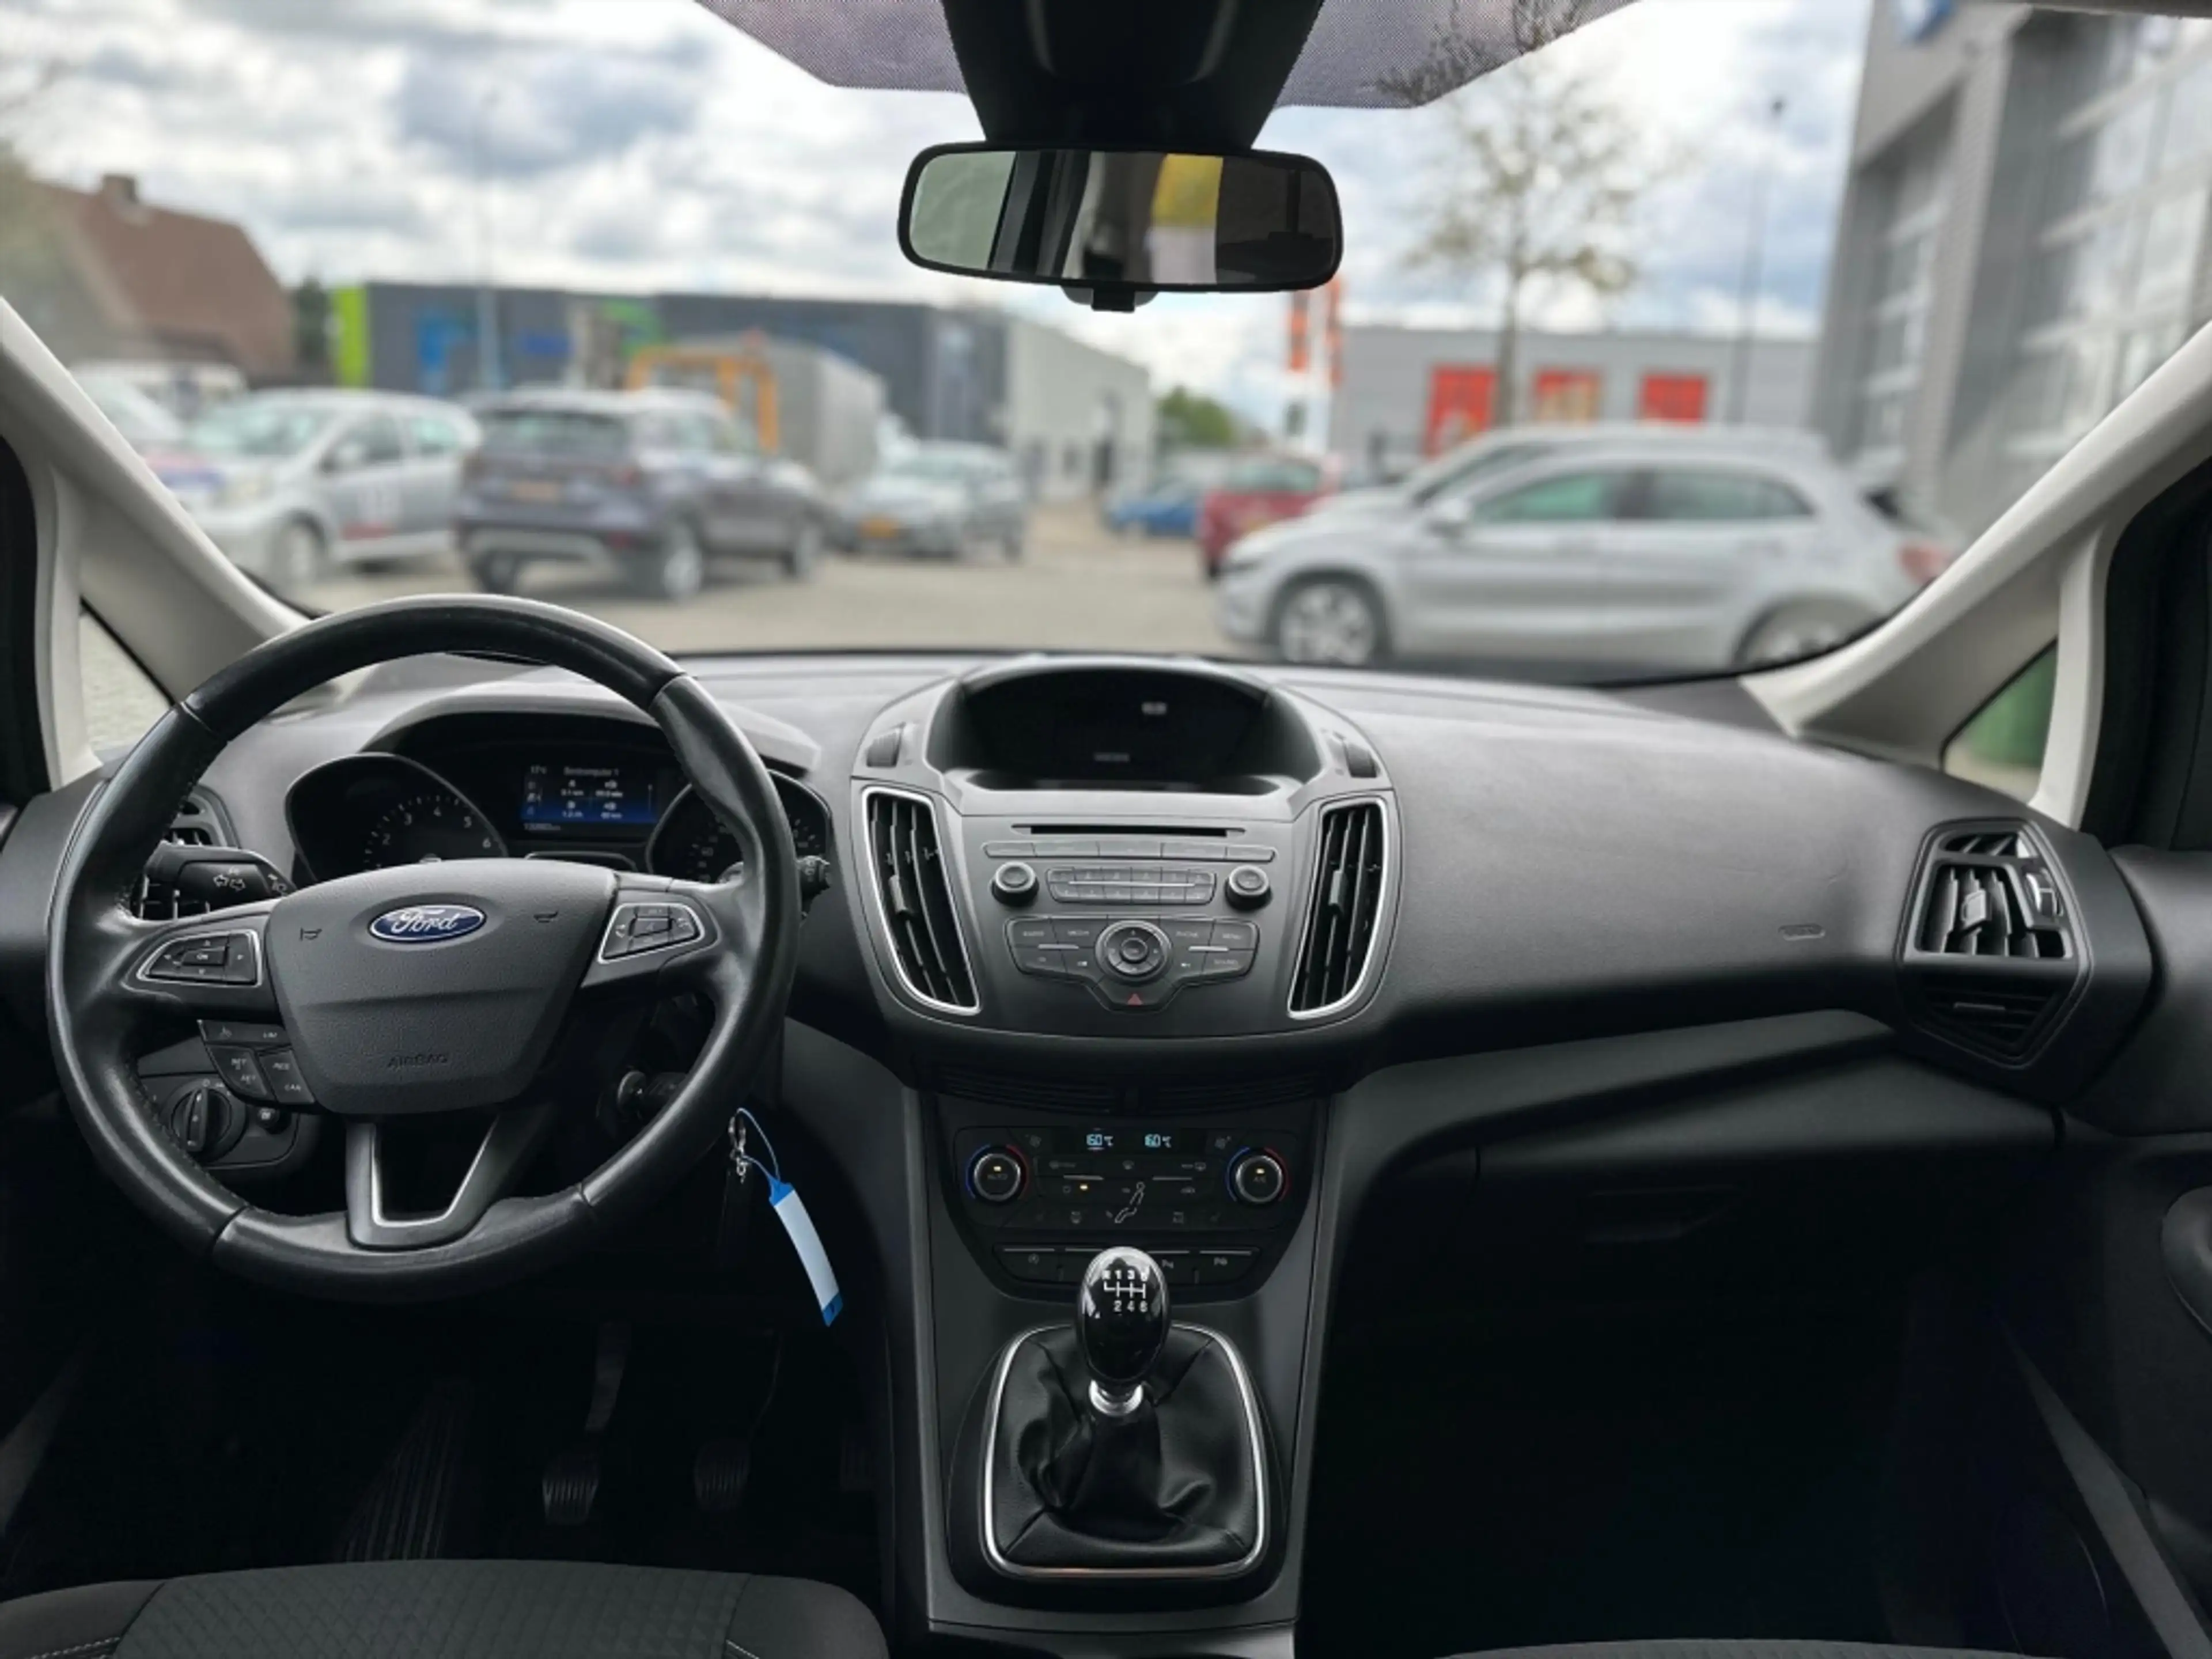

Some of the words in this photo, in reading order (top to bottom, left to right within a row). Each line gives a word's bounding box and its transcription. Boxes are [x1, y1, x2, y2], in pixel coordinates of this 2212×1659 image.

[433, 807, 441, 817] 4
[404, 813, 412, 825] 3
[382, 834, 391, 845] 2
[482, 838, 491, 849] 6
[391, 908, 460, 934] Ford
[1113, 1300, 1122, 1312] 2
[1126, 1300, 1135, 1312] 4
